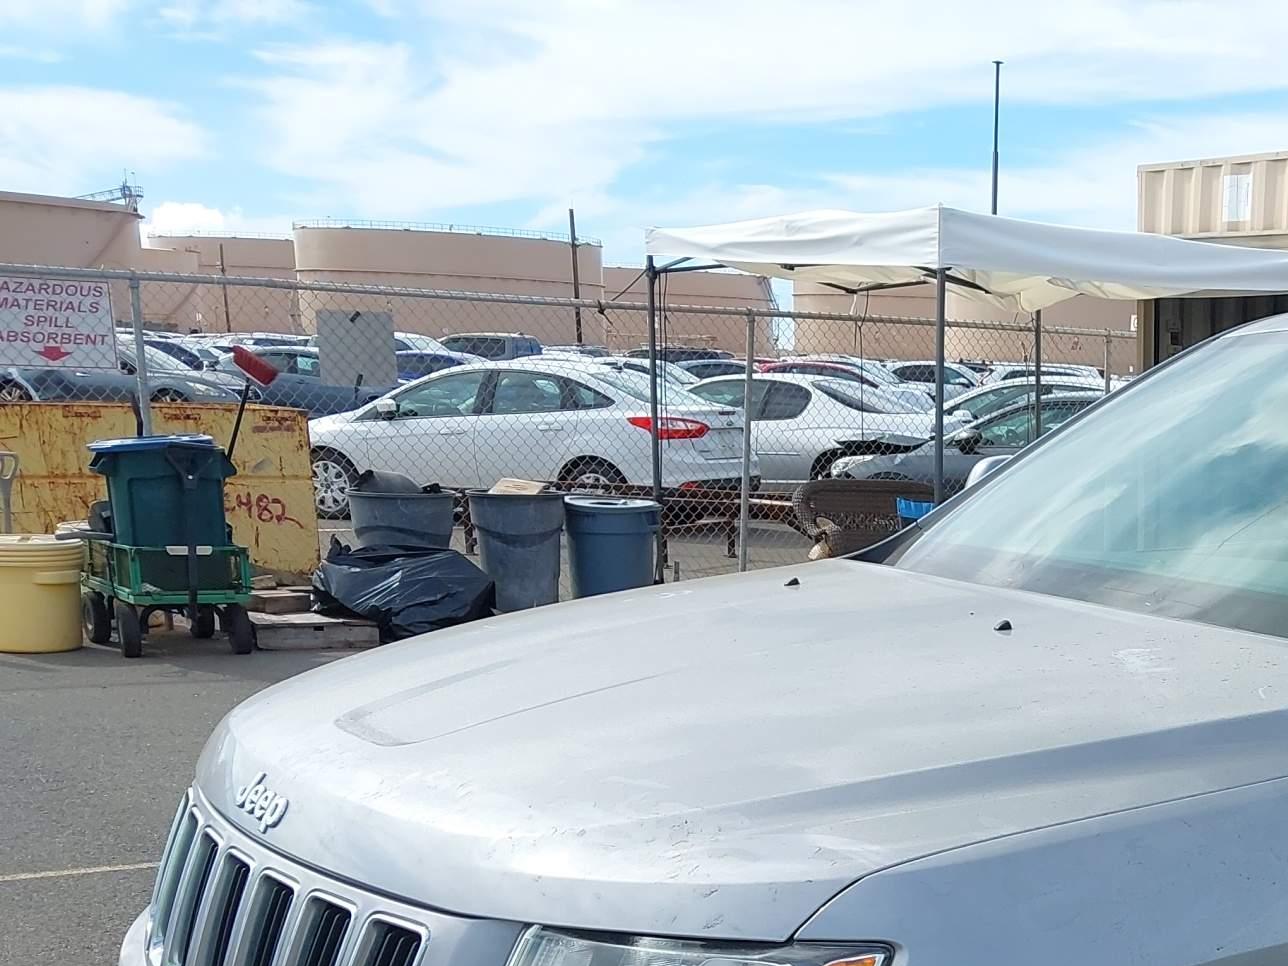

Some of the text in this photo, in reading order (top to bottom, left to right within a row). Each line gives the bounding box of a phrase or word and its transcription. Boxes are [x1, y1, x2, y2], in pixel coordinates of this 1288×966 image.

[0, 280, 103, 298] AZARDOUS
[23, 314, 75, 329] SPILL
[235, 771, 290, 834] Jeep
